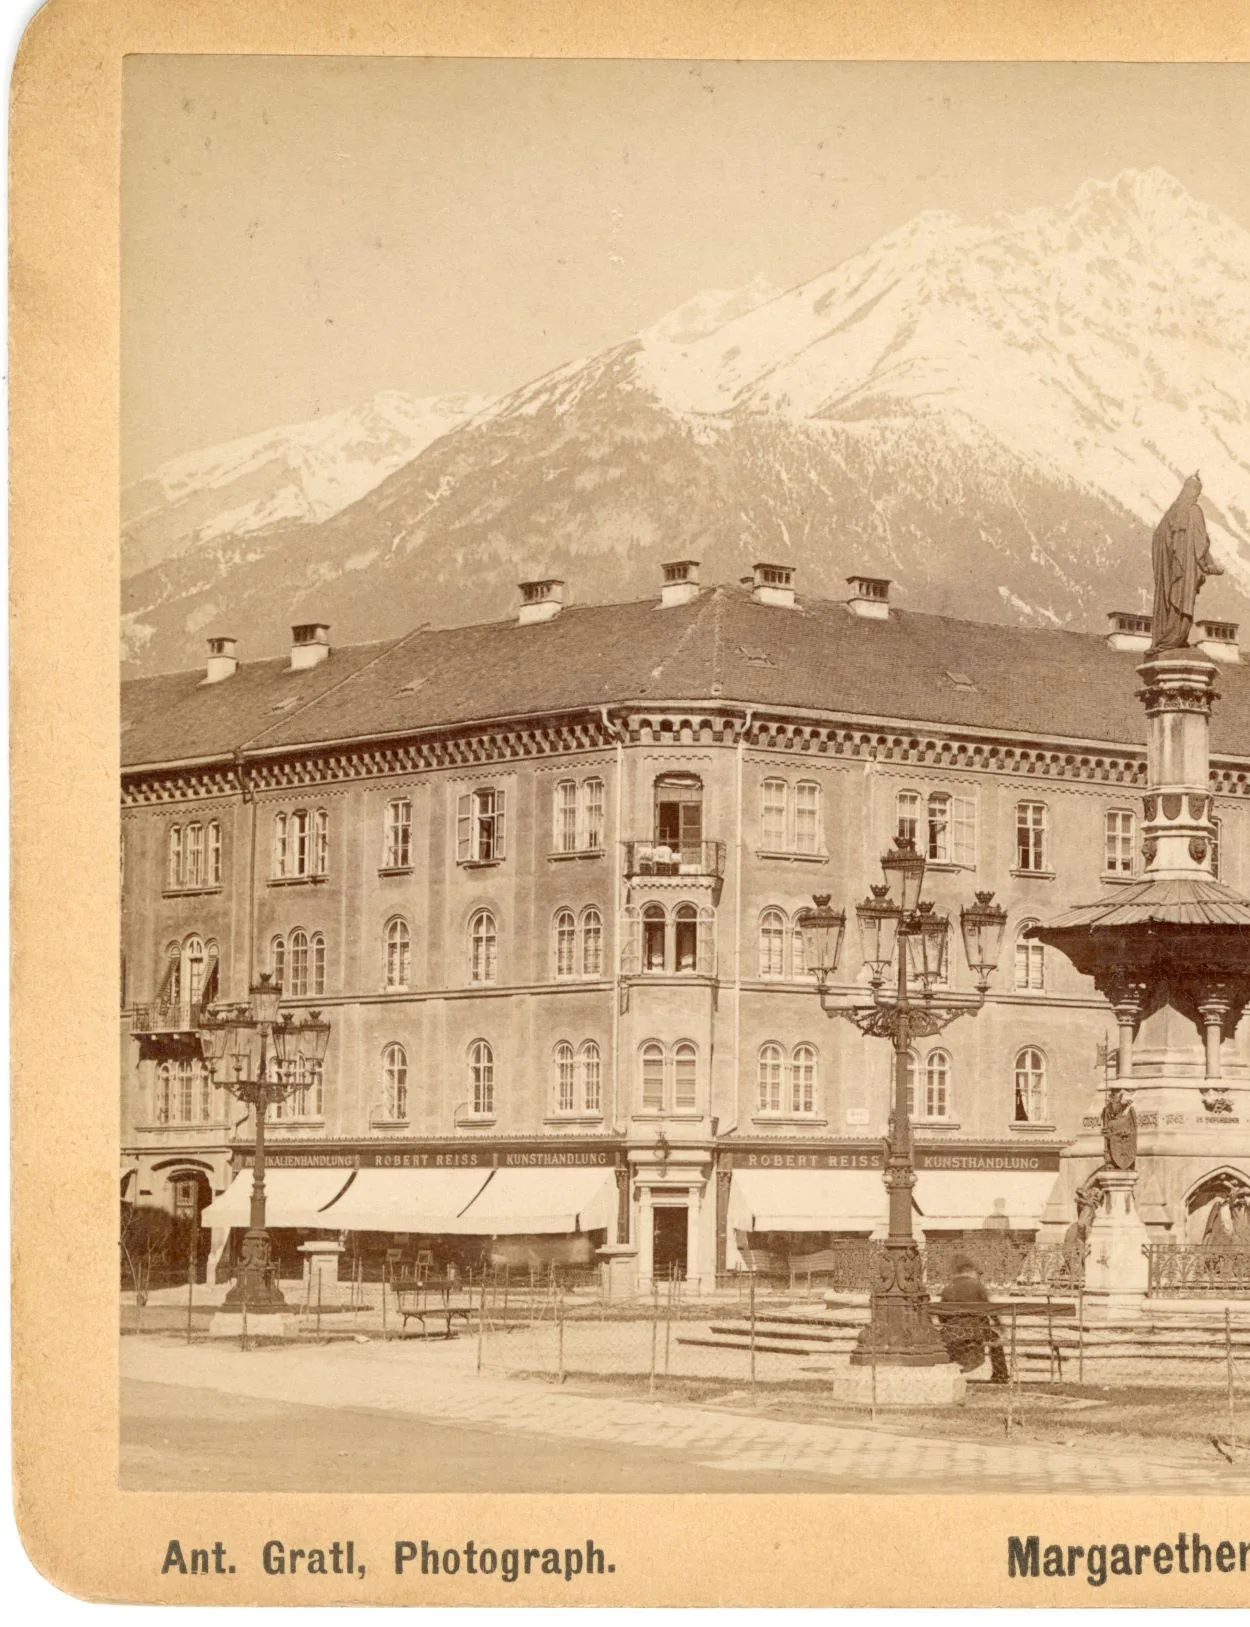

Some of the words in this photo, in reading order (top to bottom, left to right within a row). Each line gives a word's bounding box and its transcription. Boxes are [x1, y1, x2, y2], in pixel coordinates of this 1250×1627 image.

[245, 1155, 353, 1167] MIKALIENHANDLUNG
[375, 1154, 428, 1167] ROBERT
[436, 1154, 478, 1166] REISS
[506, 1152, 607, 1166] KUNSTHANDLUNG
[748, 1154, 818, 1167] ROBERT
[829, 1155, 880, 1167] REISS
[924, 1156, 1039, 1169] KUNSTHANDLUNG
